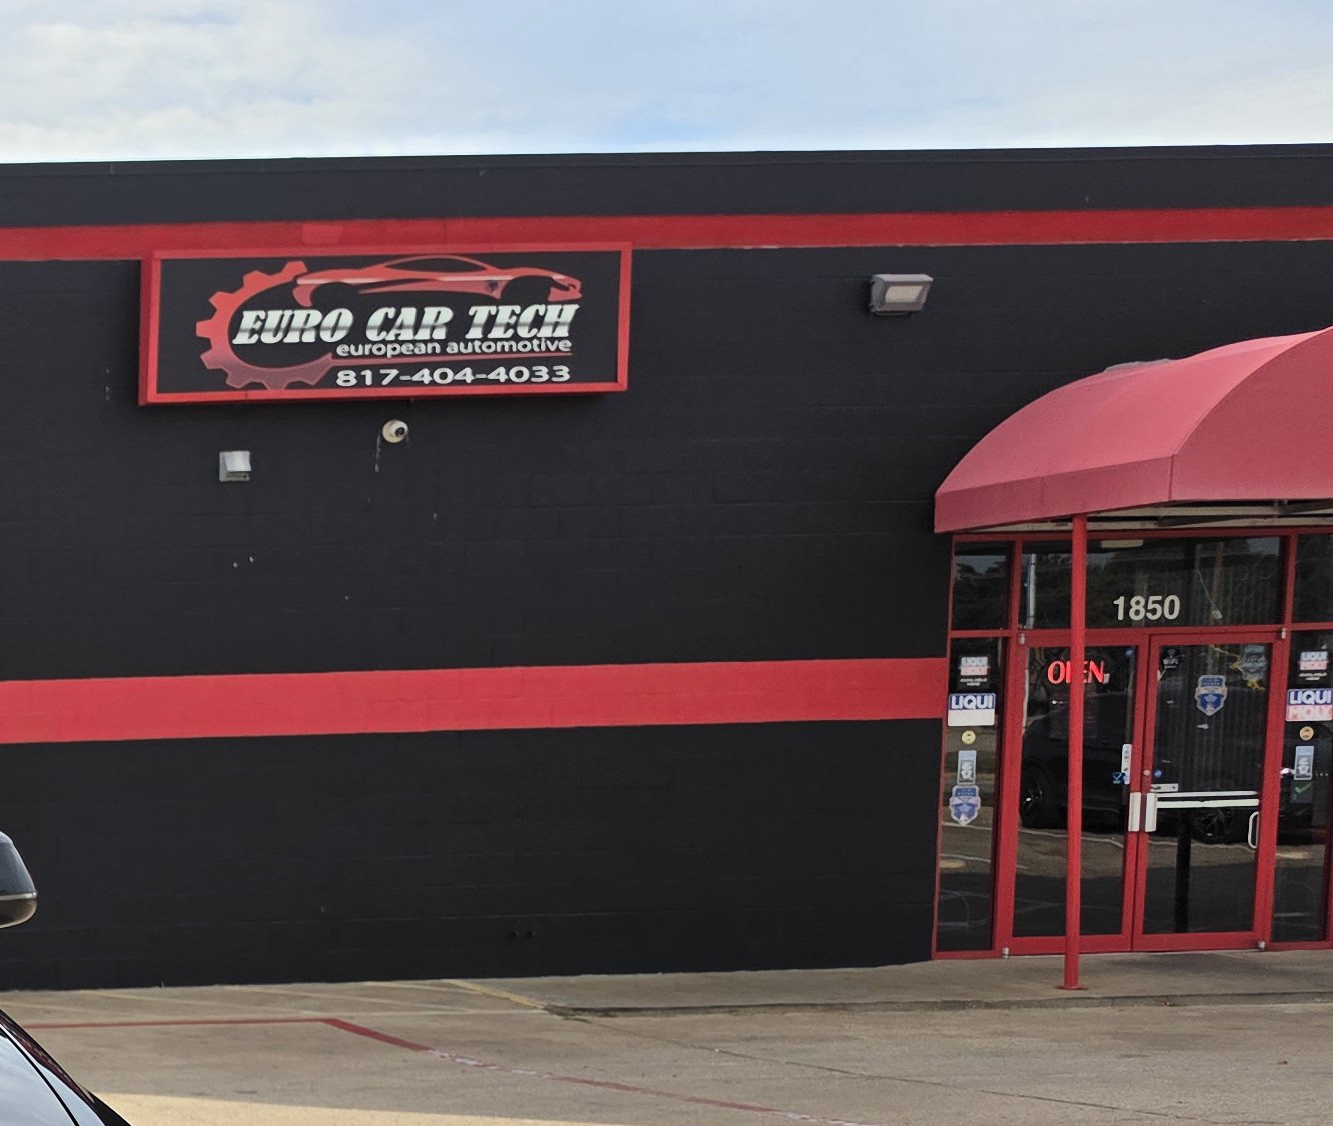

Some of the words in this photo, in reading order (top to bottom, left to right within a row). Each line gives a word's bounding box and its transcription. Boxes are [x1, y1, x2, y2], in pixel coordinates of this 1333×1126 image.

[232, 308, 354, 345] EURO
[366, 306, 454, 341] CAR
[465, 304, 580, 339] TECH
[336, 342, 441, 359] european
[446, 337, 573, 354] automotive
[336, 365, 571, 387] 817-404-4033
[1113, 594, 1181, 621] 1850
[1047, 660, 1105, 684] ON
[951, 694, 994, 710] LIQUI
[1289, 690, 1332, 705] LIQUI
